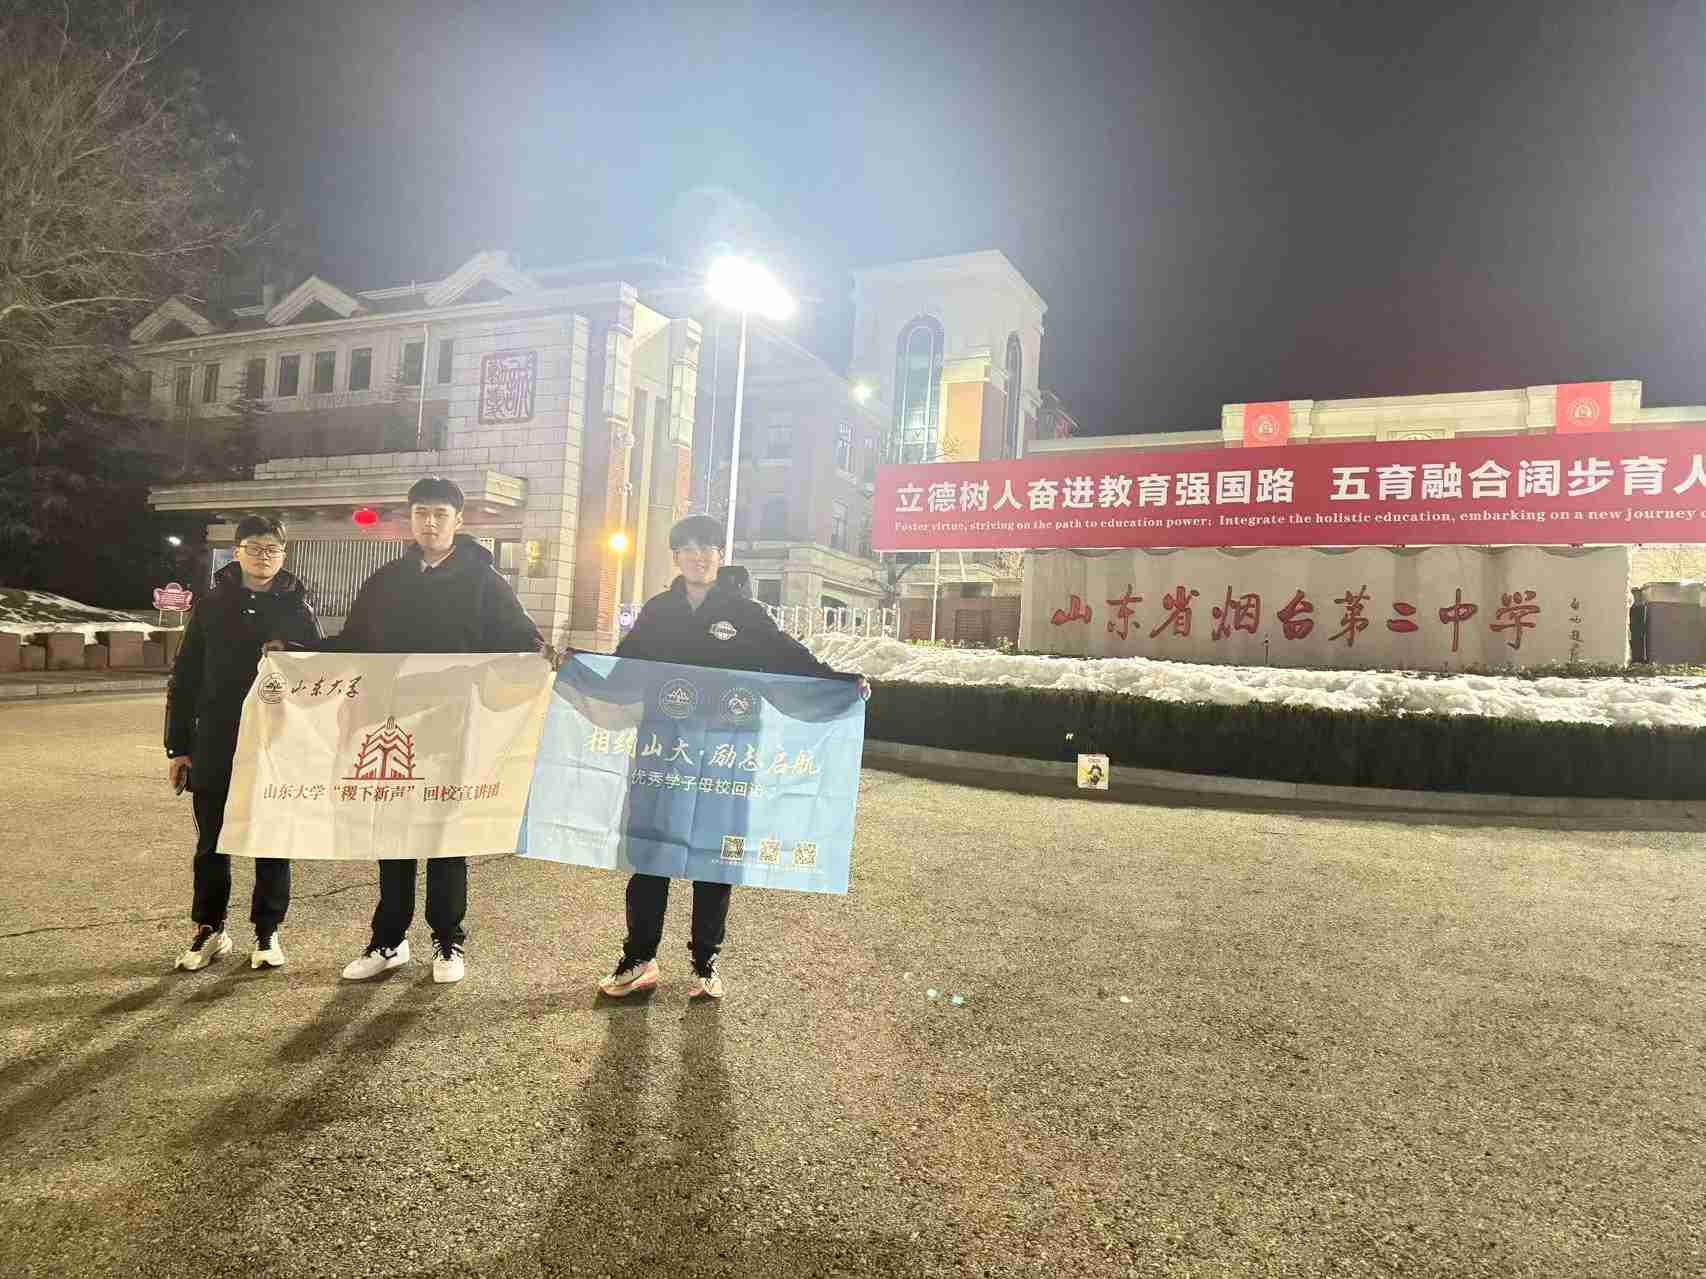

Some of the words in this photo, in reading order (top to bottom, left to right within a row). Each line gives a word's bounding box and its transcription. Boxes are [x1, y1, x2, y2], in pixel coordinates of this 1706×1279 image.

[895, 468, 1295, 513] 立德树人奋进教育强国路
[895, 521, 928, 531] Foster
[969, 519, 1014, 532] striving
[1034, 519, 1051, 529] the
[1055, 518, 1082, 529] path
[1085, 519, 1098, 528] to
[1101, 516, 1163, 528] education
[1219, 513, 1285, 527] Integrate
[1289, 513, 1312, 524] the
[1315, 512, 1371, 524] holistic
[1375, 510, 1456, 524] education,
[1459, 508, 1546, 522] embarking
[1549, 510, 1570, 520] on
[1574, 511, 1583, 520] a
[1588, 510, 1622, 520] new
[1625, 507, 1697, 521] journey
[1050, 585, 1542, 653] 山东省烟台第二中学
